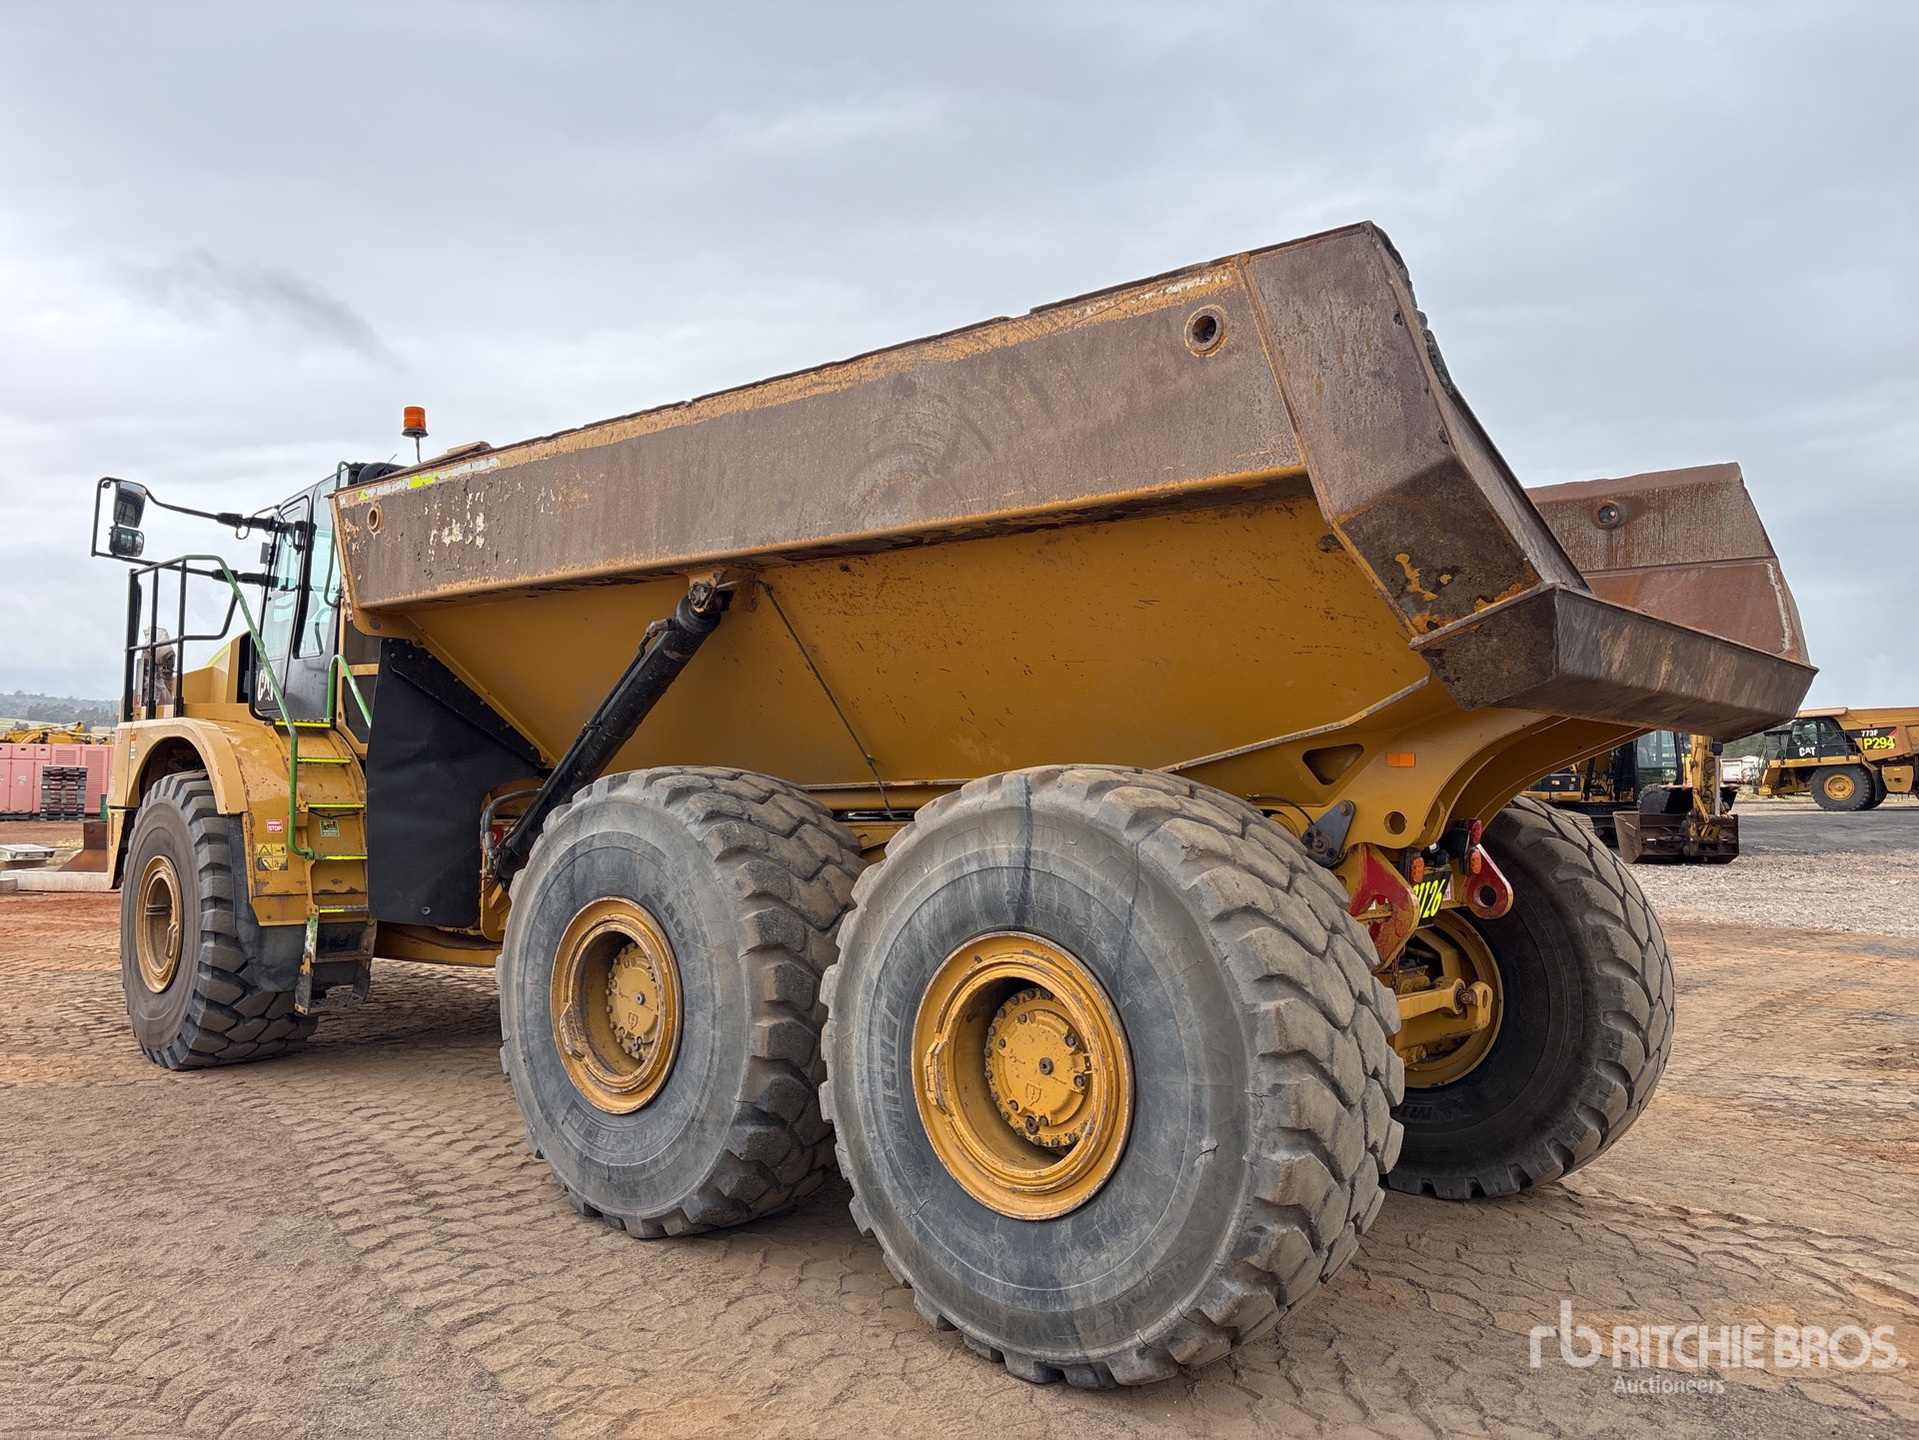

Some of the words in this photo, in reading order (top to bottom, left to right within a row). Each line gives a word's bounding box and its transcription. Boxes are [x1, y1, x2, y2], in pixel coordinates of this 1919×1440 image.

[1861, 729, 1879, 737] 773F
[1863, 737, 1895, 750] P294
[1799, 746, 1816, 757] CAT
